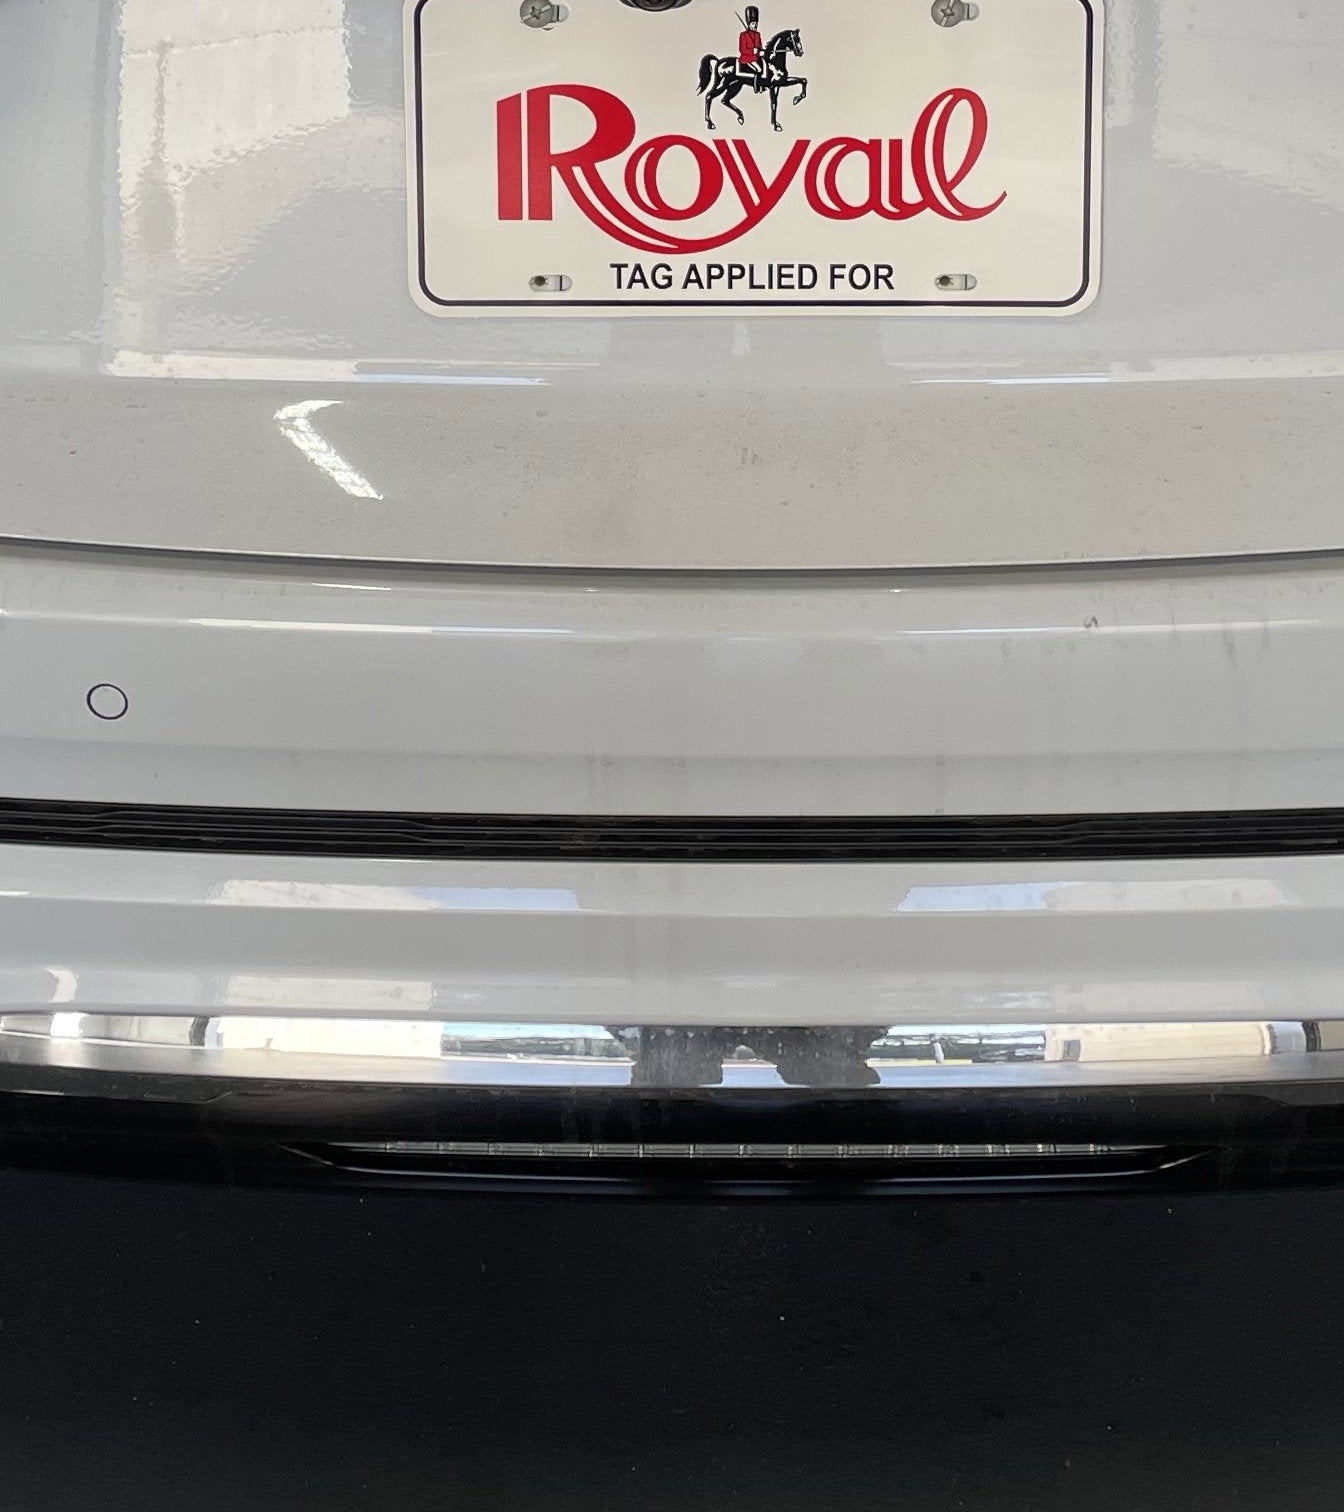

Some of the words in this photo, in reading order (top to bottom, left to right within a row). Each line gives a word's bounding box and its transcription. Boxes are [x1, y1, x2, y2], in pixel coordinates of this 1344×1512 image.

[496, 84, 1008, 255] Royal
[610, 263, 673, 291] TAG
[683, 263, 819, 291] APPLIED
[828, 263, 895, 291] FOR
